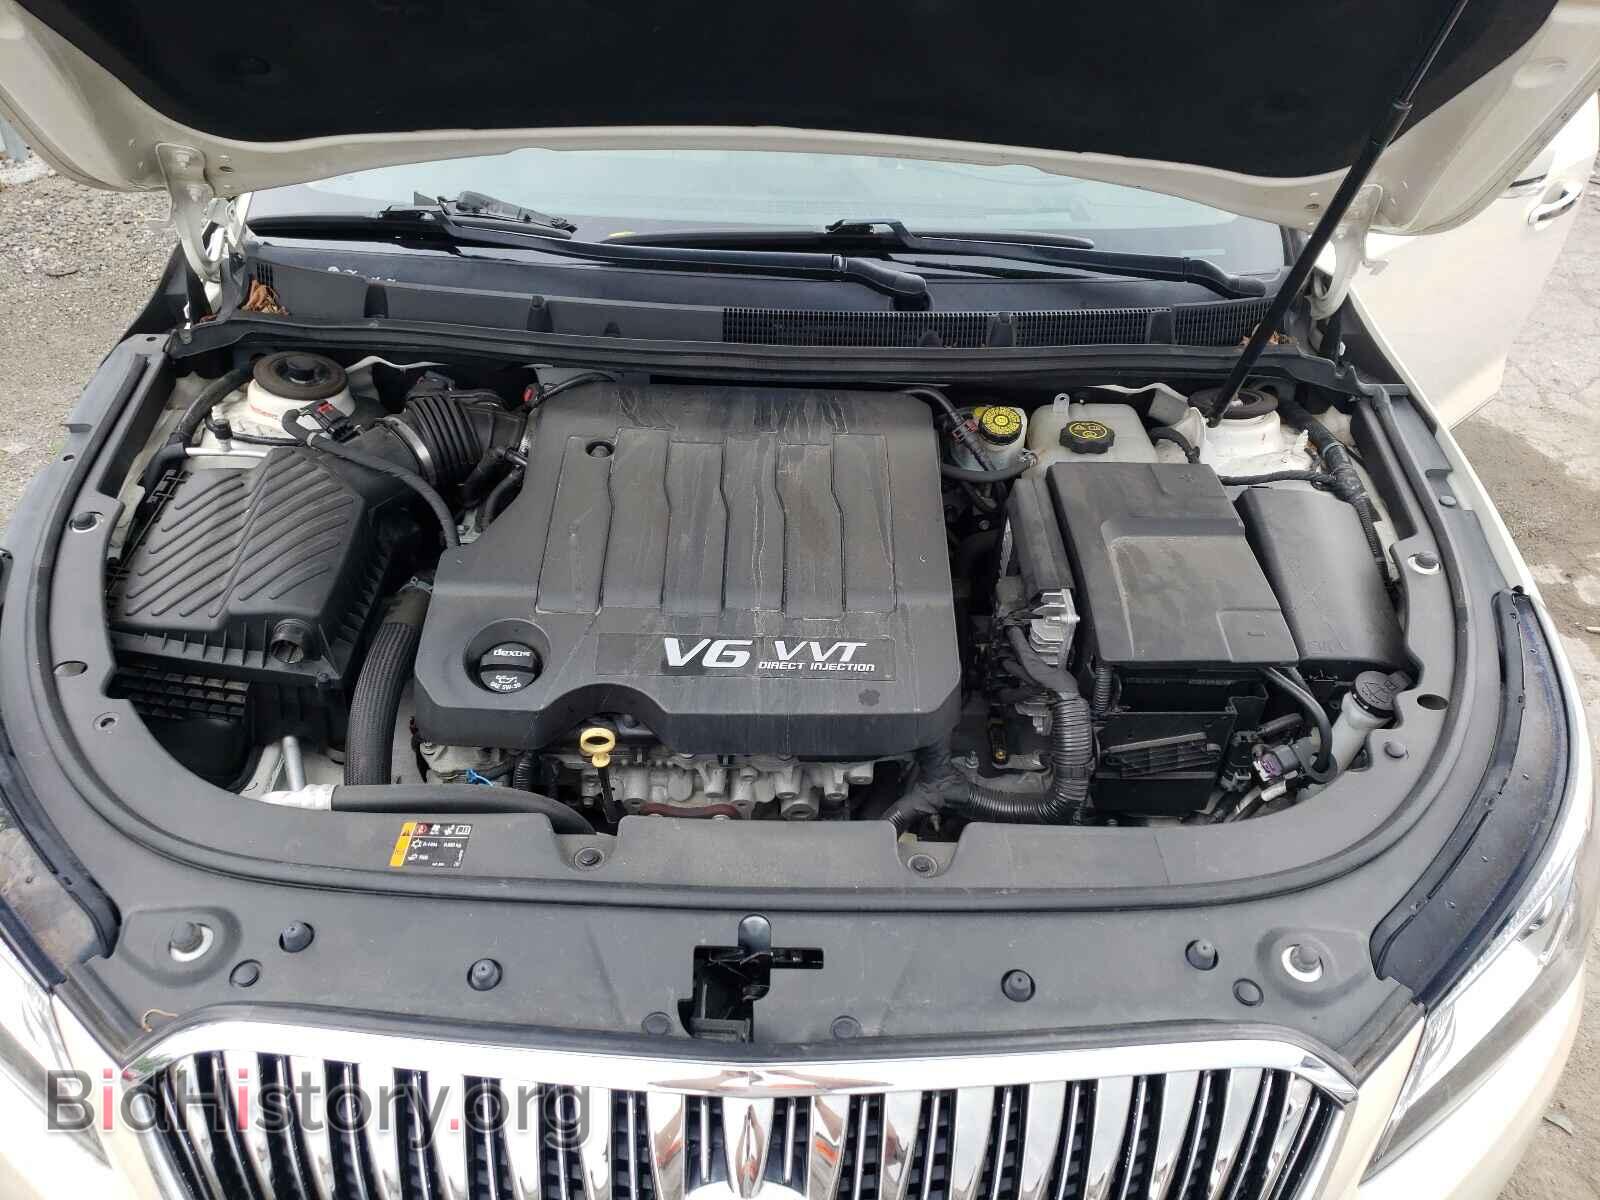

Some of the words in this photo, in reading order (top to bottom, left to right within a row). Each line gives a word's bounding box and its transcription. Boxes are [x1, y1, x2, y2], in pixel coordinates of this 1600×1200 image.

[664, 637, 753, 668] V6
[774, 640, 868, 662] VVT
[758, 661, 806, 671] DIRECT
[810, 663, 875, 672] INJECTION
